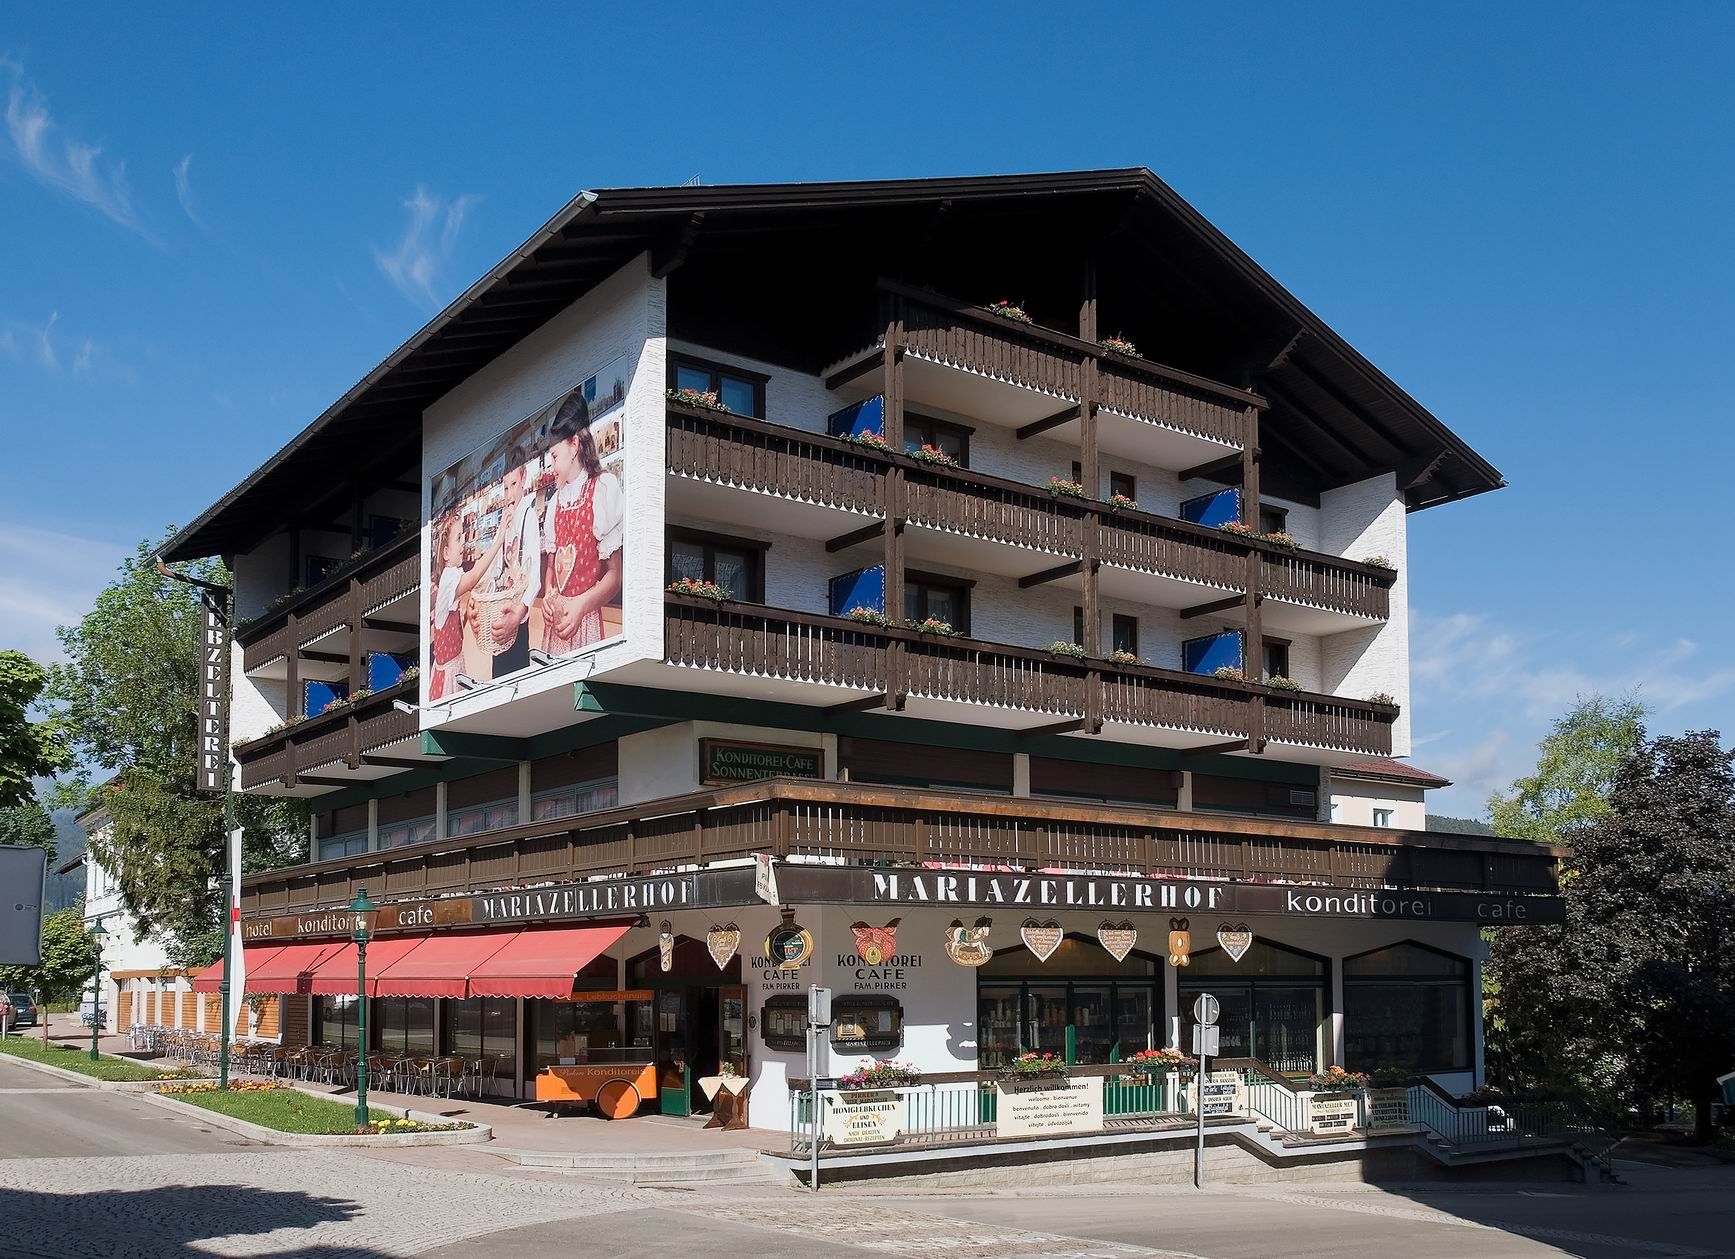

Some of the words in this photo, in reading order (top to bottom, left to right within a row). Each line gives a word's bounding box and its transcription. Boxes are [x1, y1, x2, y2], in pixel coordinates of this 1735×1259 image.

[483, 877, 693, 919] MARIAZELLERHOF
[874, 873, 1223, 908] MARIAZELLERHOF
[1287, 890, 1431, 916] konditorei
[1478, 900, 1527, 919] cafe
[246, 922, 273, 938] hotel
[399, 905, 433, 927] cafe
[763, 969, 798, 980] CAFE
[855, 968, 904, 980] CAFE
[1014, 1084, 1042, 1094] Herzlich
[1044, 1082, 1089, 1092] willkommen!
